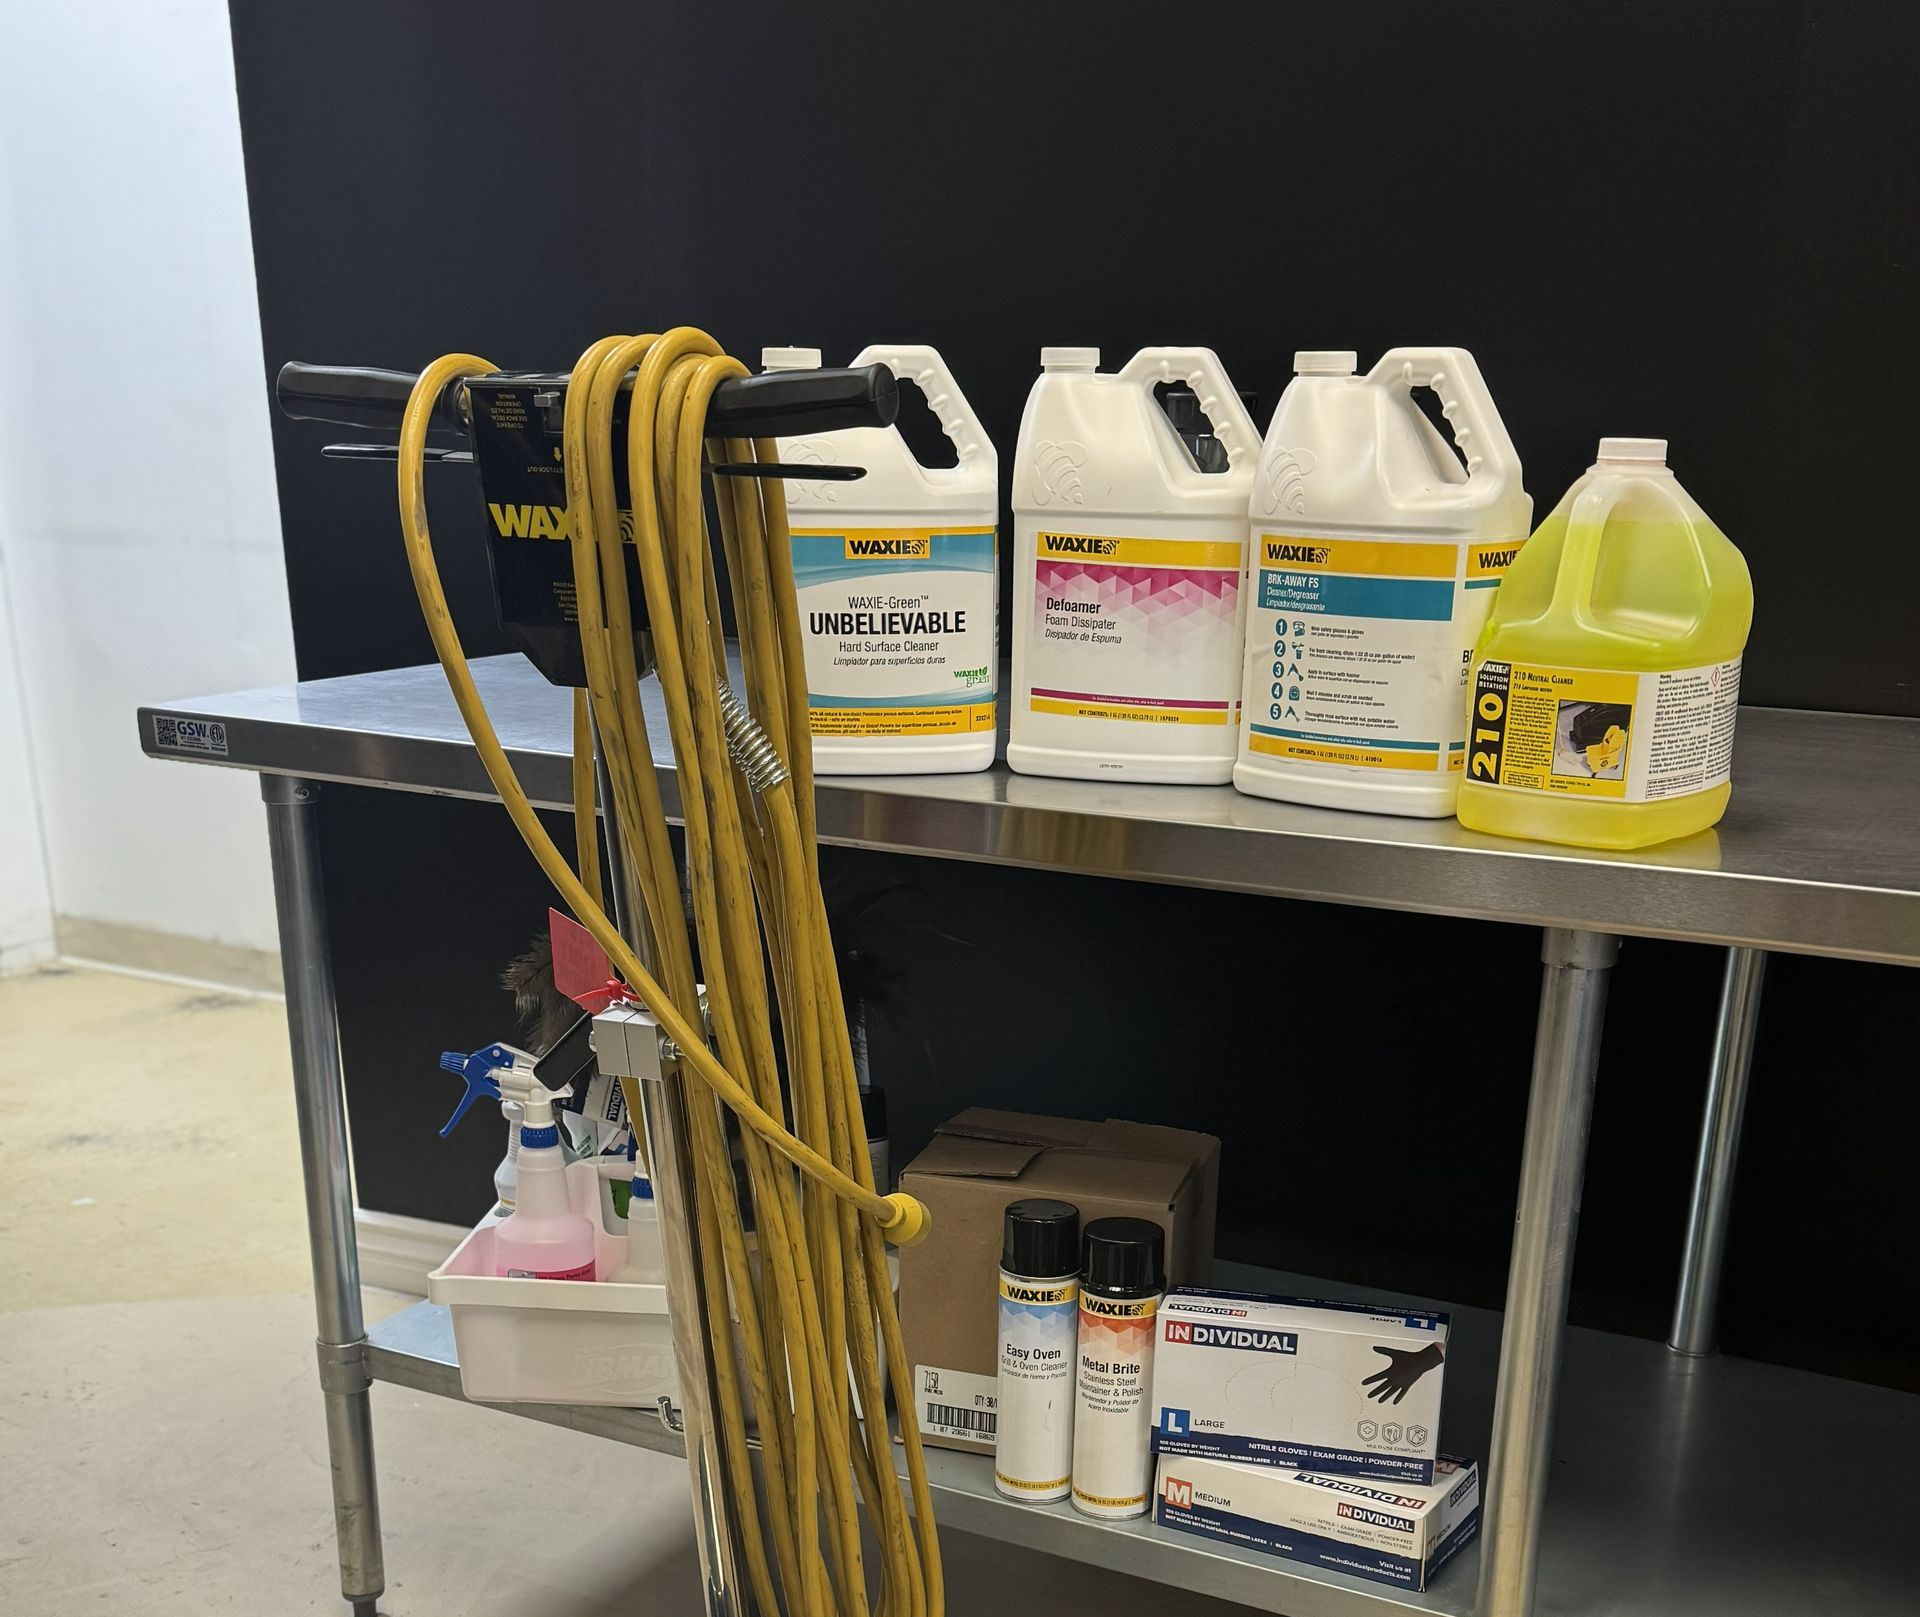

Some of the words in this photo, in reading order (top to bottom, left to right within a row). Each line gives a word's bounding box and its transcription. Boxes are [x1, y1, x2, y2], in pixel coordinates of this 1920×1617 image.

[489, 503, 572, 540] WAX
[849, 540, 912, 555] WAXIE
[1045, 536, 1103, 554] WAXIE
[1267, 544, 1316, 562] WAXIE
[1308, 578, 1319, 588] FS
[1046, 597, 1102, 614] Defoamer
[809, 610, 966, 636] UNBELIEVABLE
[1045, 614, 1069, 627] Foam
[1071, 616, 1116, 631] Dissipater
[1045, 629, 1078, 642] Disipador
[1080, 632, 1090, 642] de
[1091, 633, 1122, 644] Espuma
[839, 641, 862, 653] Hard
[864, 640, 901, 652] Surface
[904, 640, 940, 652] Cleaner
[834, 656, 869, 666] Limpiador
[870, 658, 886, 666] para
[926, 656, 946, 665] duras
[1480, 674, 1509, 683] SOLUTION
[1514, 671, 1526, 680] 210
[177, 722, 206, 738] GSW
[1471, 693, 1504, 780] 210
[1008, 1285, 1054, 1302] WAXIE
[1085, 1298, 1132, 1316] WAXIE
[1168, 1324, 1294, 1352] INDIVIDUAL
[1006, 1344, 1030, 1360] Easy
[1034, 1348, 1060, 1360] Oven
[1012, 1360, 1018, 1368] &
[1020, 1362, 1038, 1371] Oven
[1041, 1362, 1068, 1371] Cleaner
[1082, 1356, 1108, 1373] Metal
[1112, 1364, 1140, 1374] Brite
[1084, 1371, 1114, 1386] Stainless
[1116, 1378, 1136, 1386] Steel
[1122, 1388, 1144, 1396] Polish
[1194, 1419, 1225, 1428] LARGE
[1248, 1443, 1276, 1452] NITRILE
[1278, 1446, 1308, 1456] GLOVES
[1313, 1452, 1336, 1460] EXAM
[1337, 1454, 1364, 1464] GRADE
[1368, 1458, 1424, 1470] POWDER-FREE
[1166, 1482, 1190, 1506] M
[1195, 1492, 1231, 1507] MEDIUM
[1299, 1474, 1422, 1508] INDIVIDUAL
[1339, 1504, 1414, 1532] INDIVIDUAL
[1379, 1560, 1394, 1570] Visit
